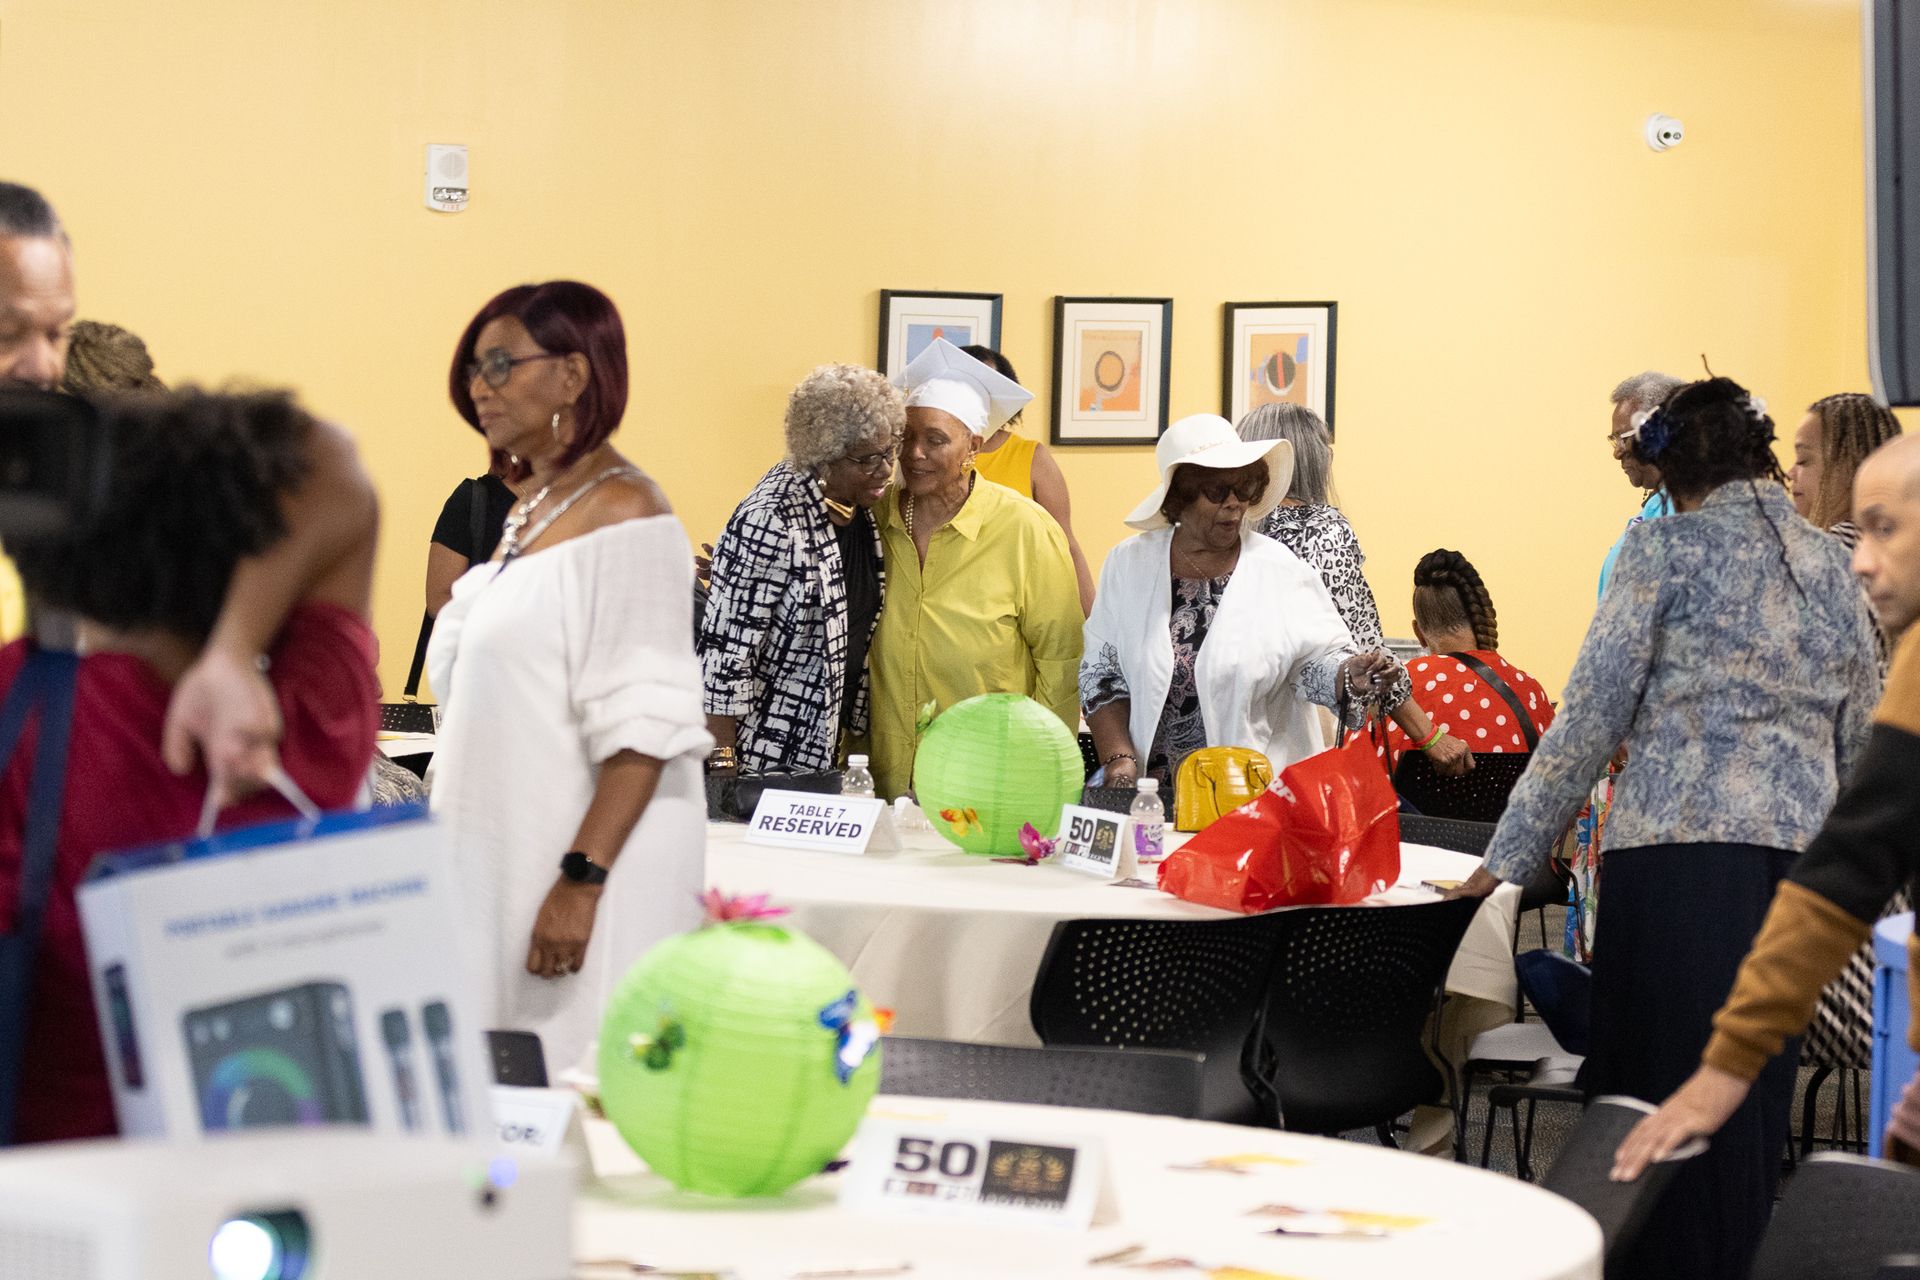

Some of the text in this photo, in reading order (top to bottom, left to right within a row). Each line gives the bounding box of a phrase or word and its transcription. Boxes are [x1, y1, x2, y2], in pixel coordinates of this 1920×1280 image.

[789, 803, 847, 819] TABLE 7
[758, 815, 863, 839] RESERVED
[1069, 816, 1095, 844] 50
[894, 1137, 979, 1178] 50
